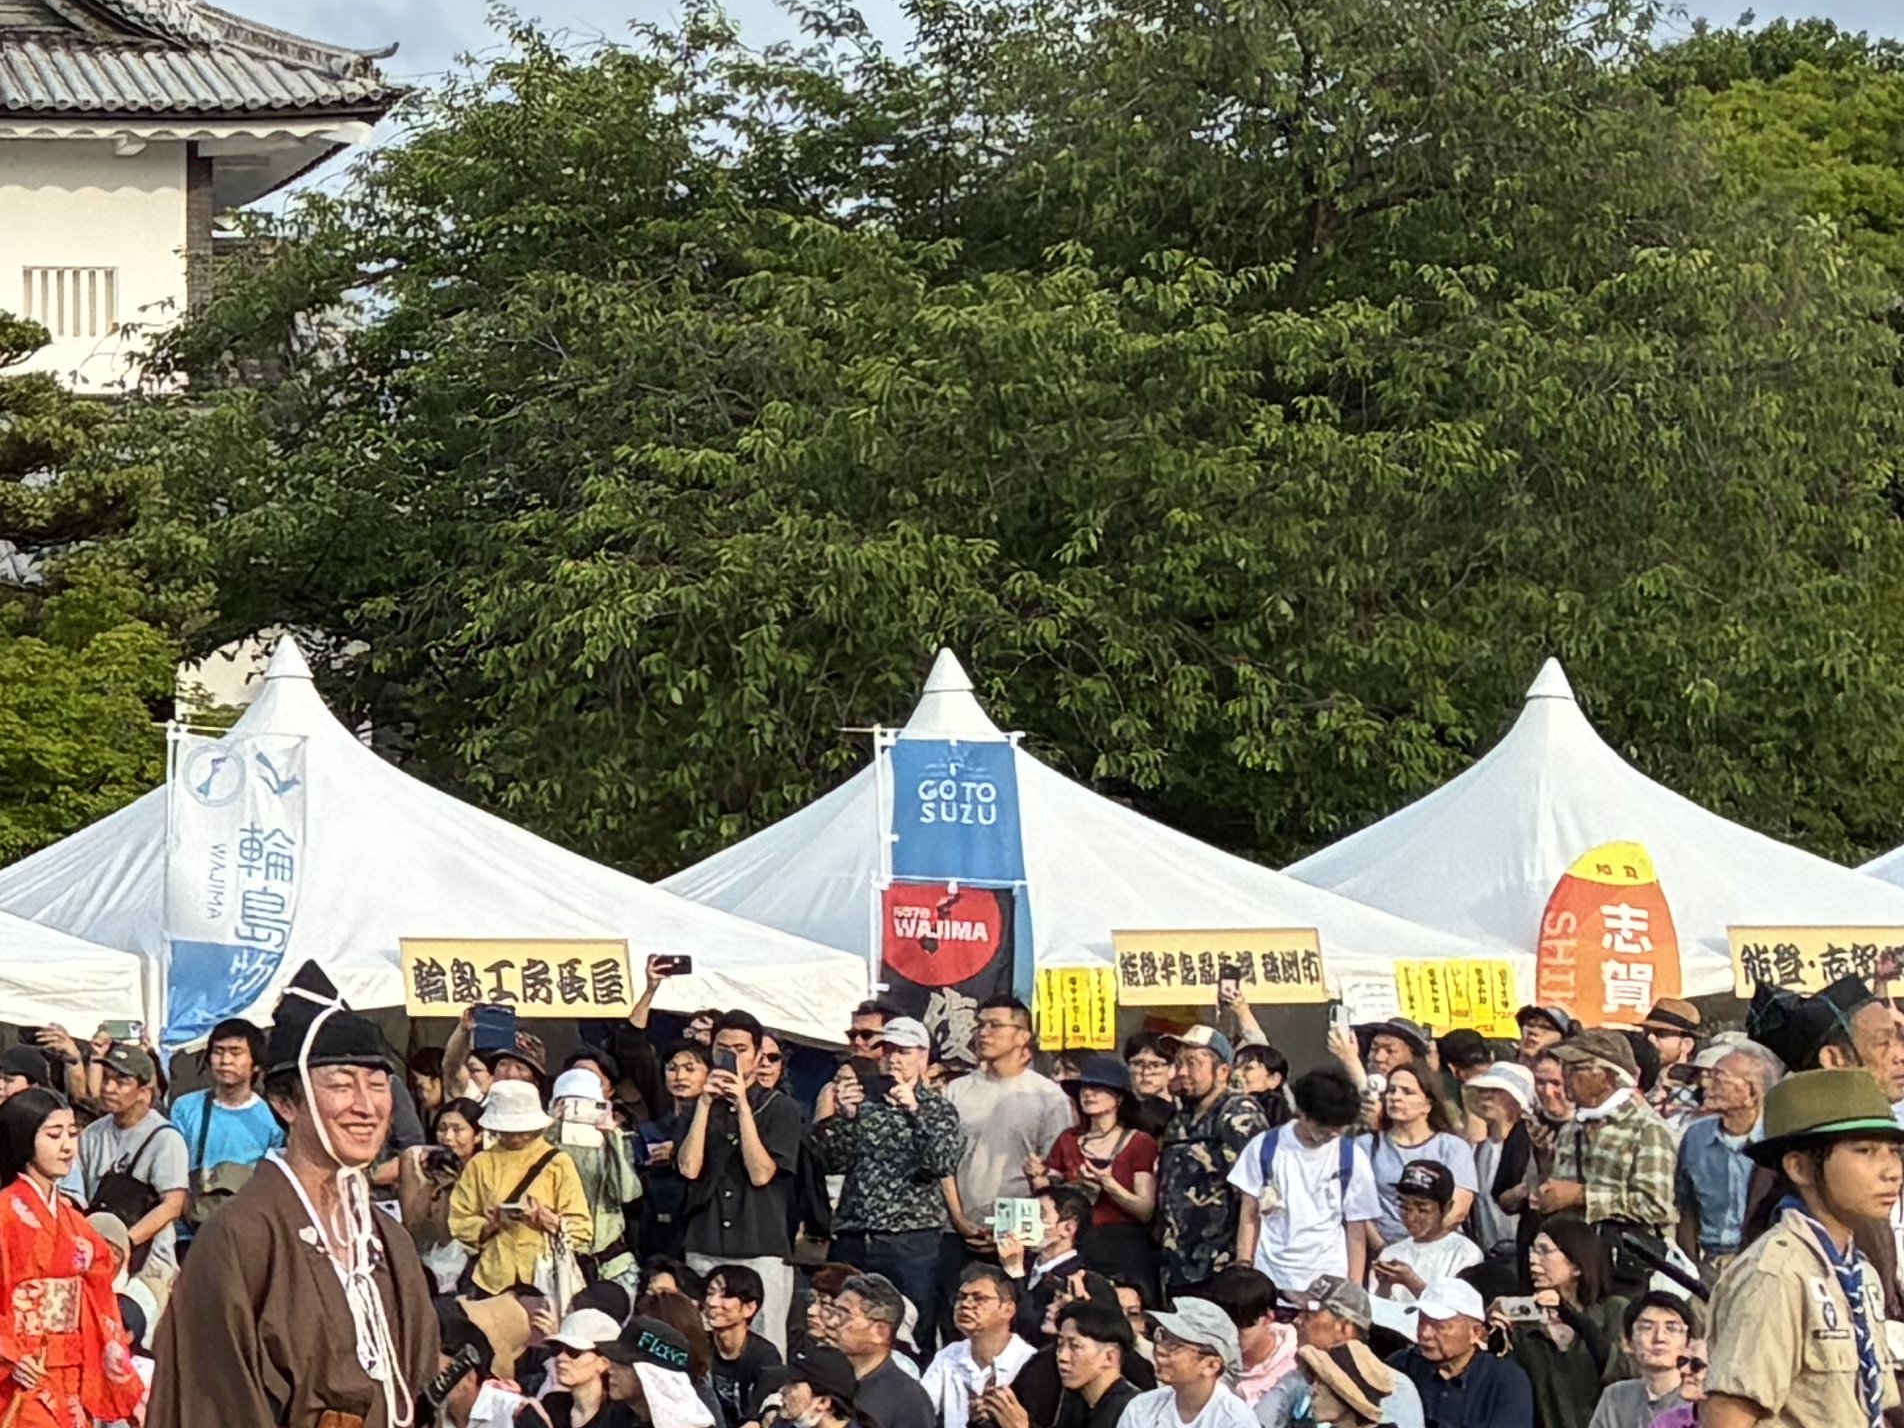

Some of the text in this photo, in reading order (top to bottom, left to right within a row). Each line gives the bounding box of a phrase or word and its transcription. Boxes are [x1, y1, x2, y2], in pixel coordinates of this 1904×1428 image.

[919, 803, 997, 825] SUZU
[206, 843, 226, 920] WAJIMA
[893, 919, 989, 942] WAJIMA
[1600, 902, 1655, 1031] 志賀
[1741, 943, 1904, 985] 能登・志賀
